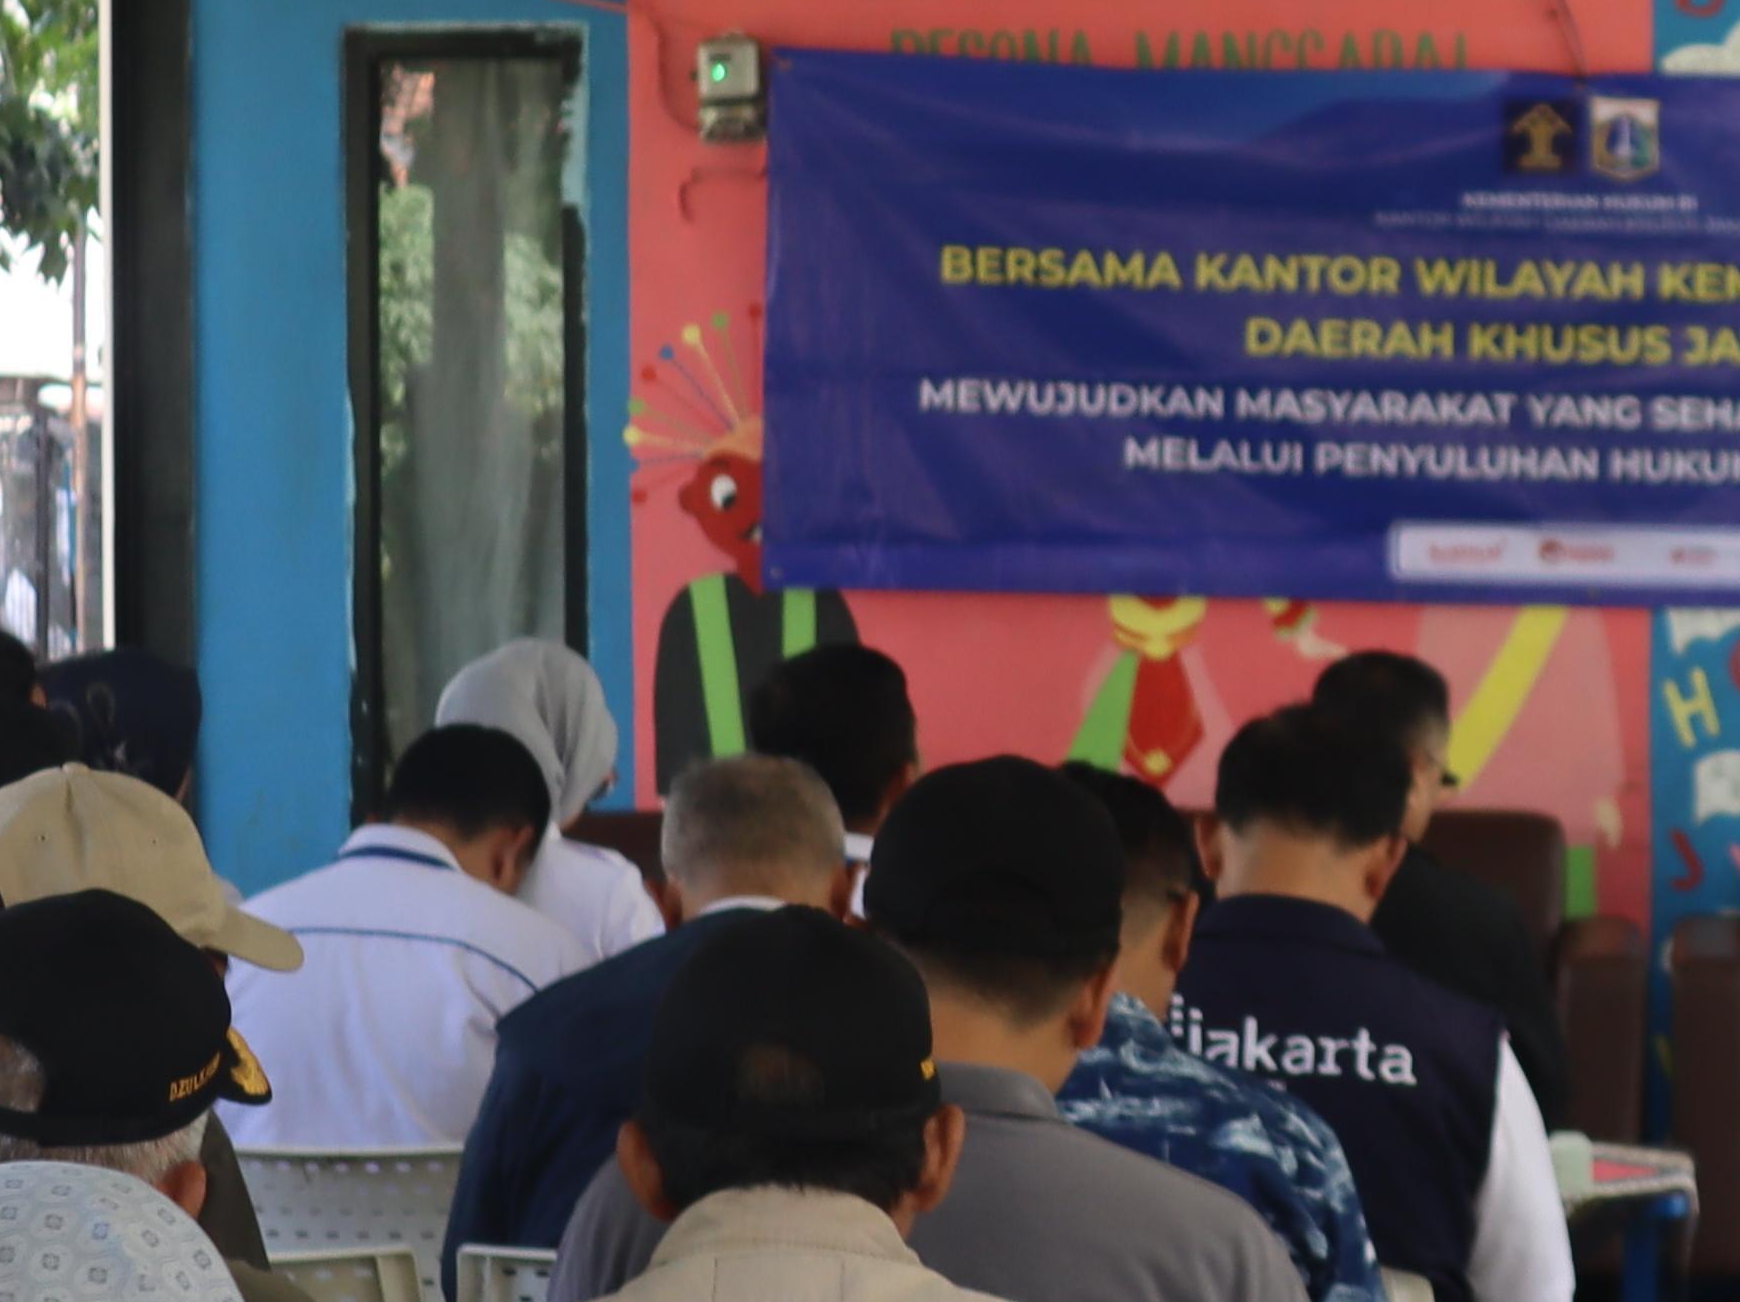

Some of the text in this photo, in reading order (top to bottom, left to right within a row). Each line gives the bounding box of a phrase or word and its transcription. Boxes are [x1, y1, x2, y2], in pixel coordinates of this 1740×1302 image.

[940, 245, 1182, 289] BERSAMA
[1195, 252, 1402, 295] KANTOR
[1416, 258, 1645, 301] WILAYAH
[1245, 317, 1455, 360] DAERAH
[1467, 323, 1672, 366] KHUSUS
[919, 378, 1224, 418] MEWUJUDKAN
[1235, 386, 1513, 427] MASYARAKAT
[1528, 394, 1641, 430] YANG
[1123, 436, 1303, 473] MELALUI
[1315, 441, 1600, 481] PENYULUHAN
